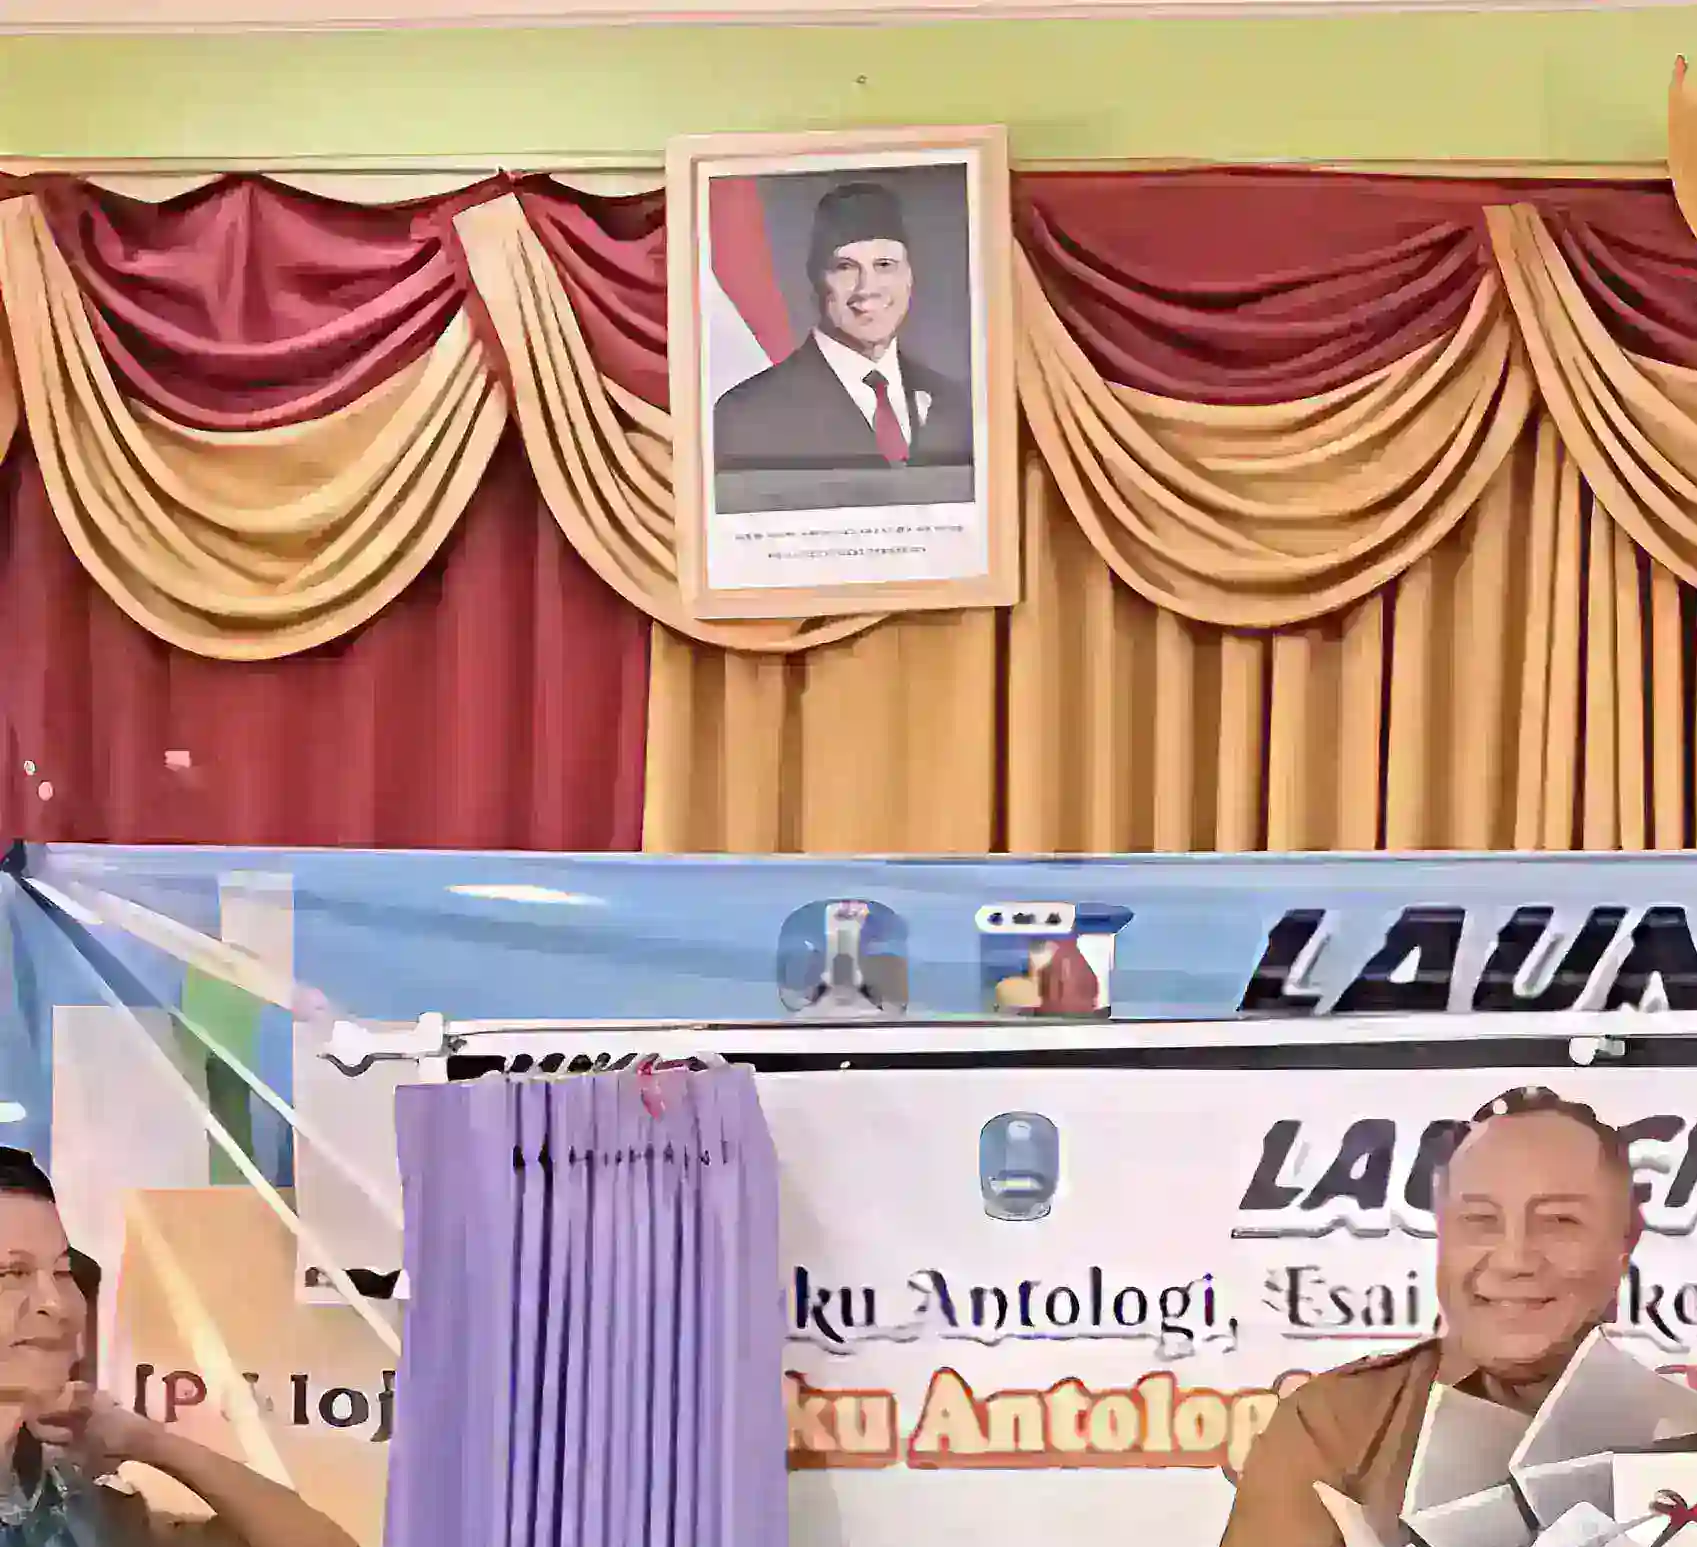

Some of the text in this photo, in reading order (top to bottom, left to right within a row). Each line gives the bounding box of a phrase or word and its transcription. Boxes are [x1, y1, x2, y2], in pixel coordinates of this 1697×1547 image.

[795, 1264, 876, 1345] ku
[907, 1264, 1238, 1353] Antologi,
[785, 1366, 1313, 1478] ku Antolog
